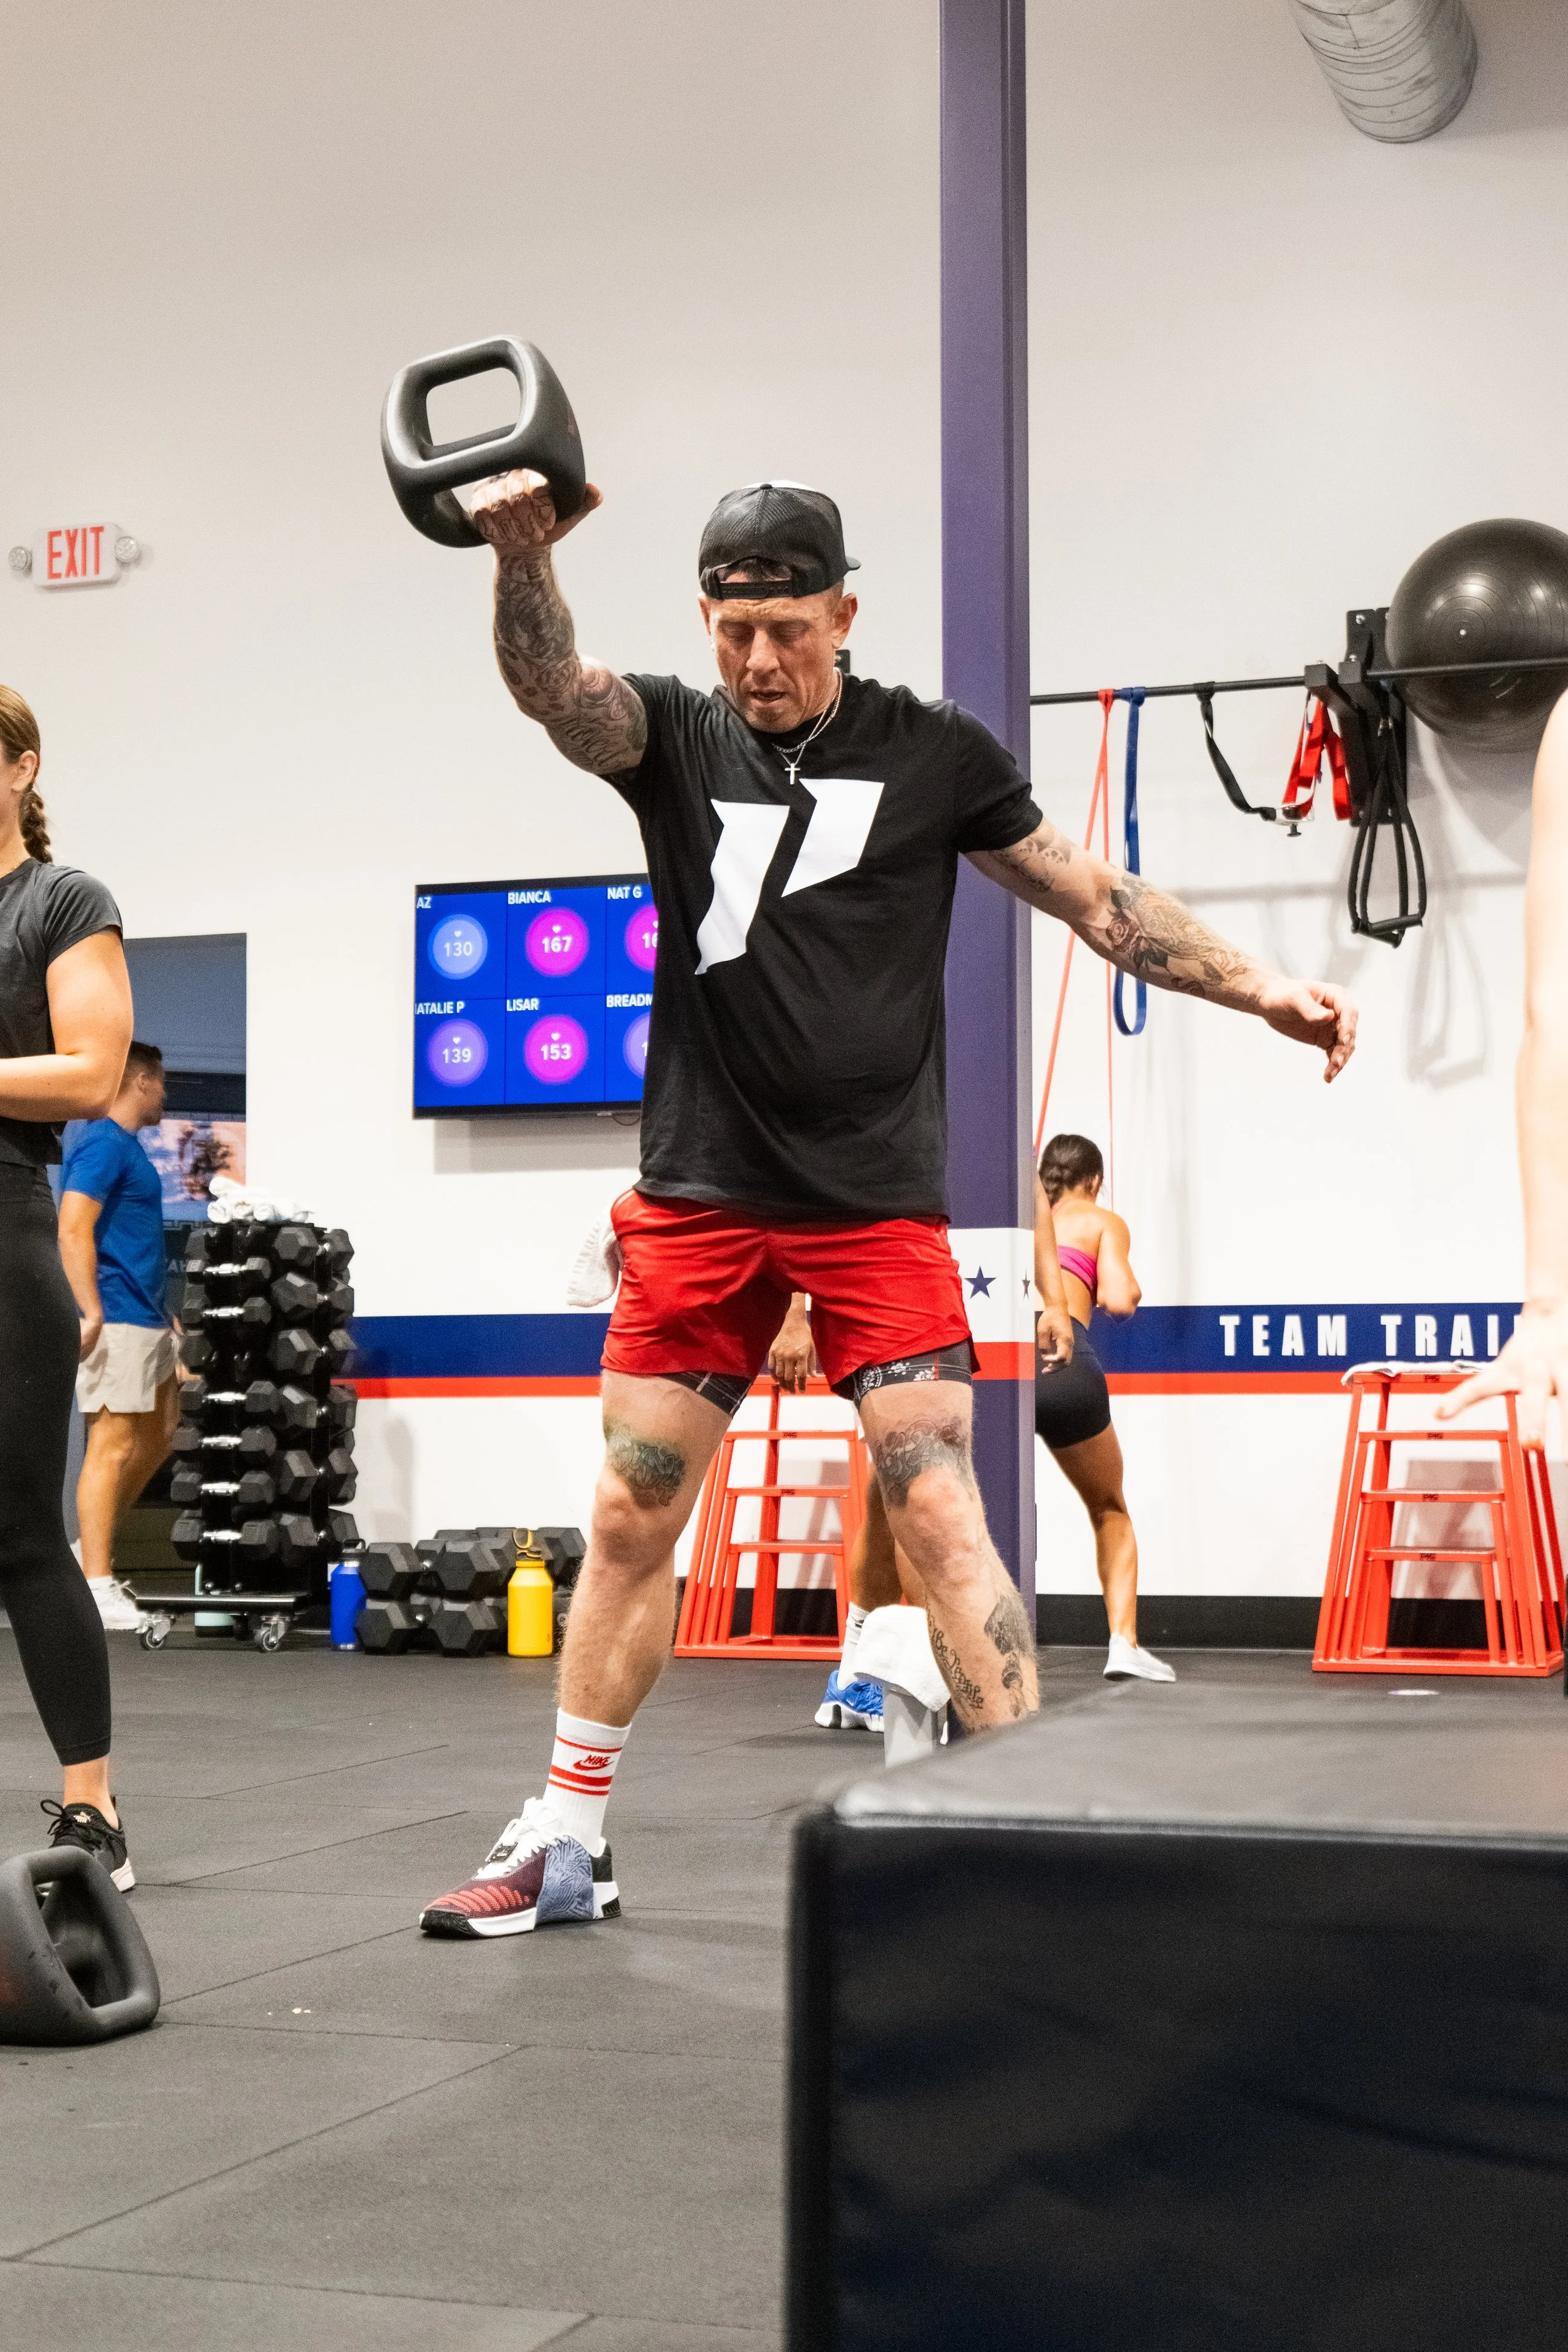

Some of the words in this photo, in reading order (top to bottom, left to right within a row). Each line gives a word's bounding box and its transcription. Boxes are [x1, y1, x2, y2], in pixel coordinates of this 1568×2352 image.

[47, 526, 104, 580] EXIT
[507, 890, 551, 904] BIANCA
[607, 887, 630, 899] NAT
[632, 886, 643, 899] G
[443, 941, 473, 957] 130
[541, 936, 573, 953] 167
[456, 1000, 465, 1014] P
[506, 998, 539, 1012] LISAR
[442, 1048, 472, 1064] 139
[540, 1044, 572, 1061] 153
[1219, 1315, 1347, 1357] TEAM
[583, 1754, 611, 1766] NIKE
